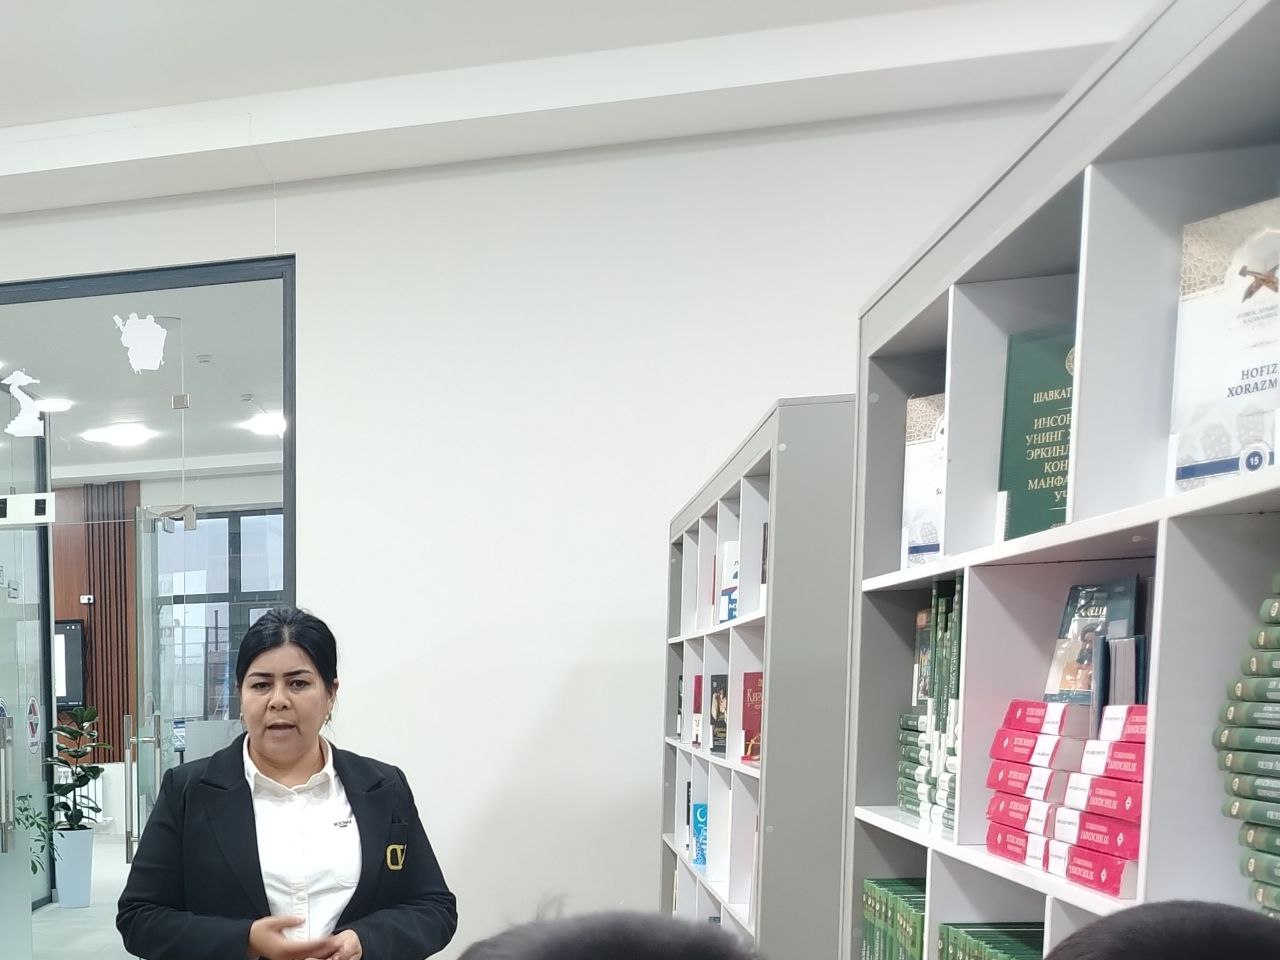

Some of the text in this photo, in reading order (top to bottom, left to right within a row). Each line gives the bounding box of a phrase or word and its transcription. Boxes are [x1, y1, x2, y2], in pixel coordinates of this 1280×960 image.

[1241, 363, 1278, 381] HOFIZ
[1033, 387, 1072, 403] ШАВКАТ
[1227, 377, 1278, 398] XORAZM
[1026, 429, 1065, 446] УНИНГ
[1250, 456, 1260, 466] 15
